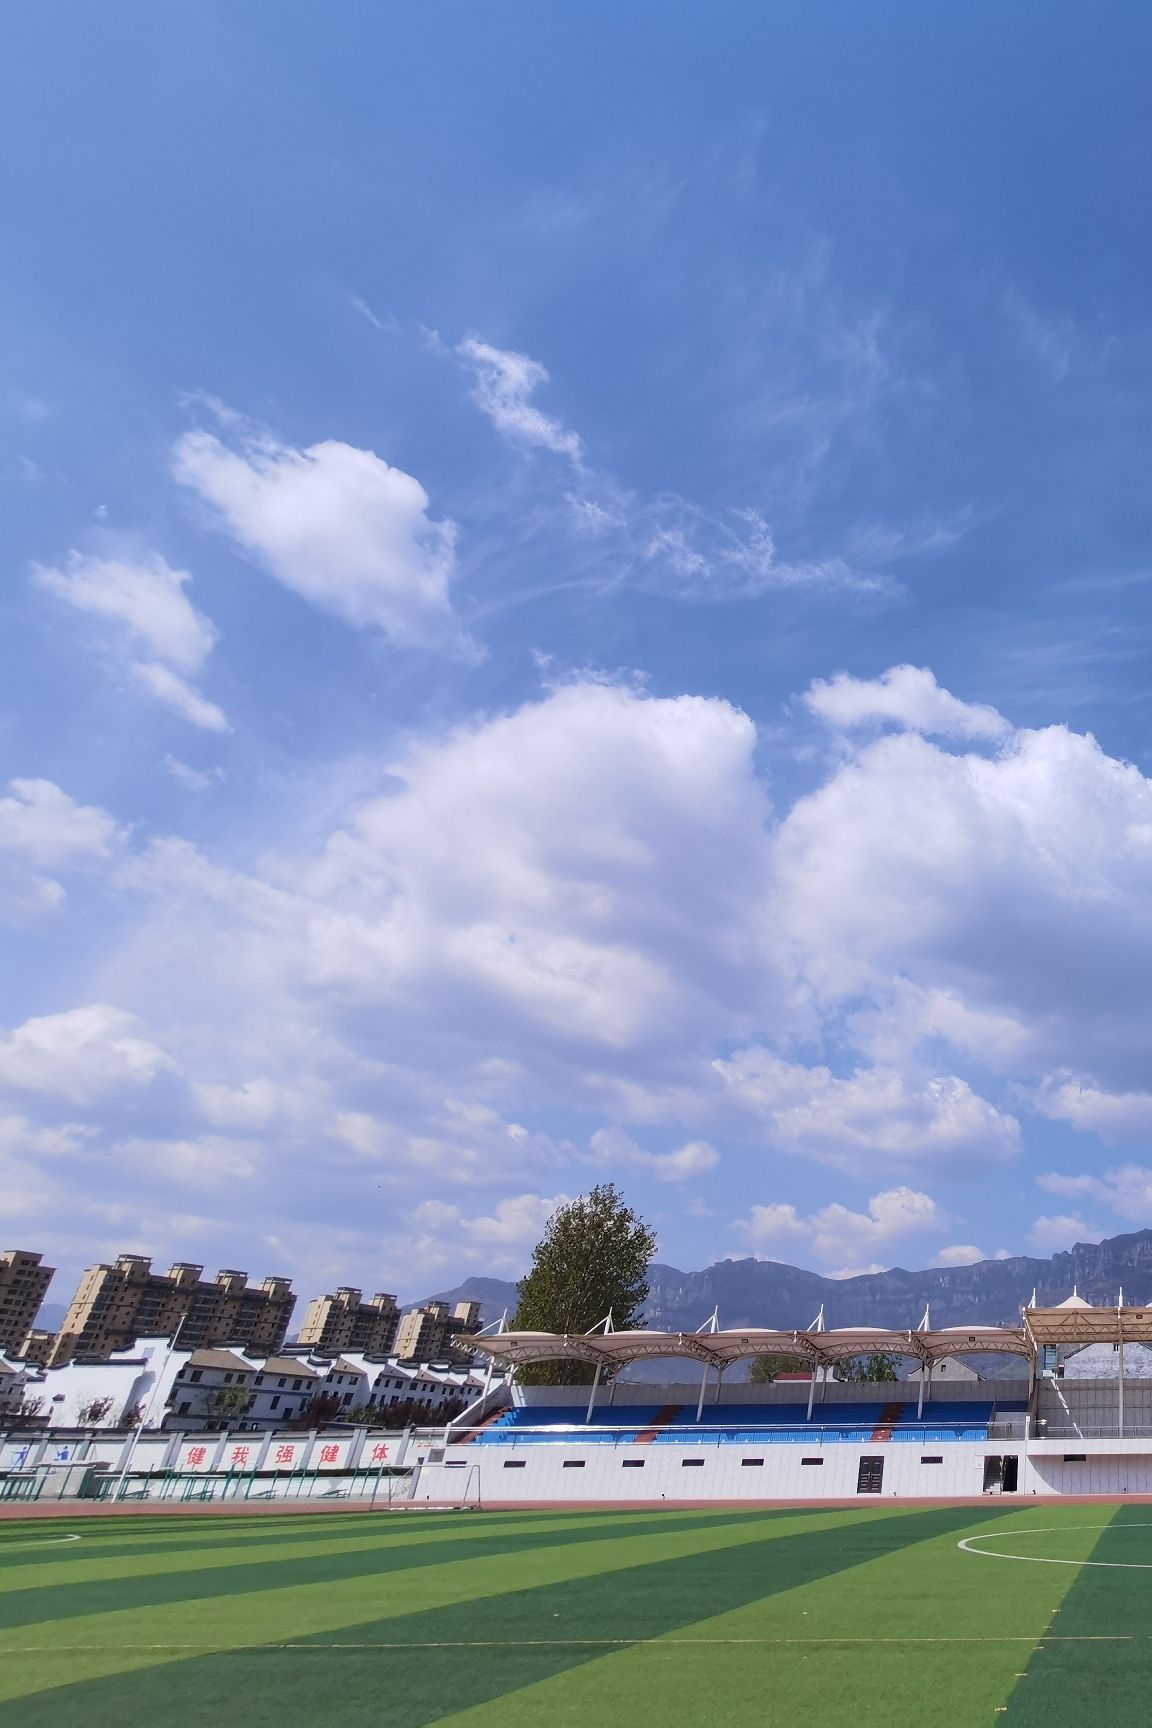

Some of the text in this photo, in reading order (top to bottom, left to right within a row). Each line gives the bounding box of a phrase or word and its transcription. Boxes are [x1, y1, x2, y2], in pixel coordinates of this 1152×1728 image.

[186, 1443, 434, 1466] 健我强健体
